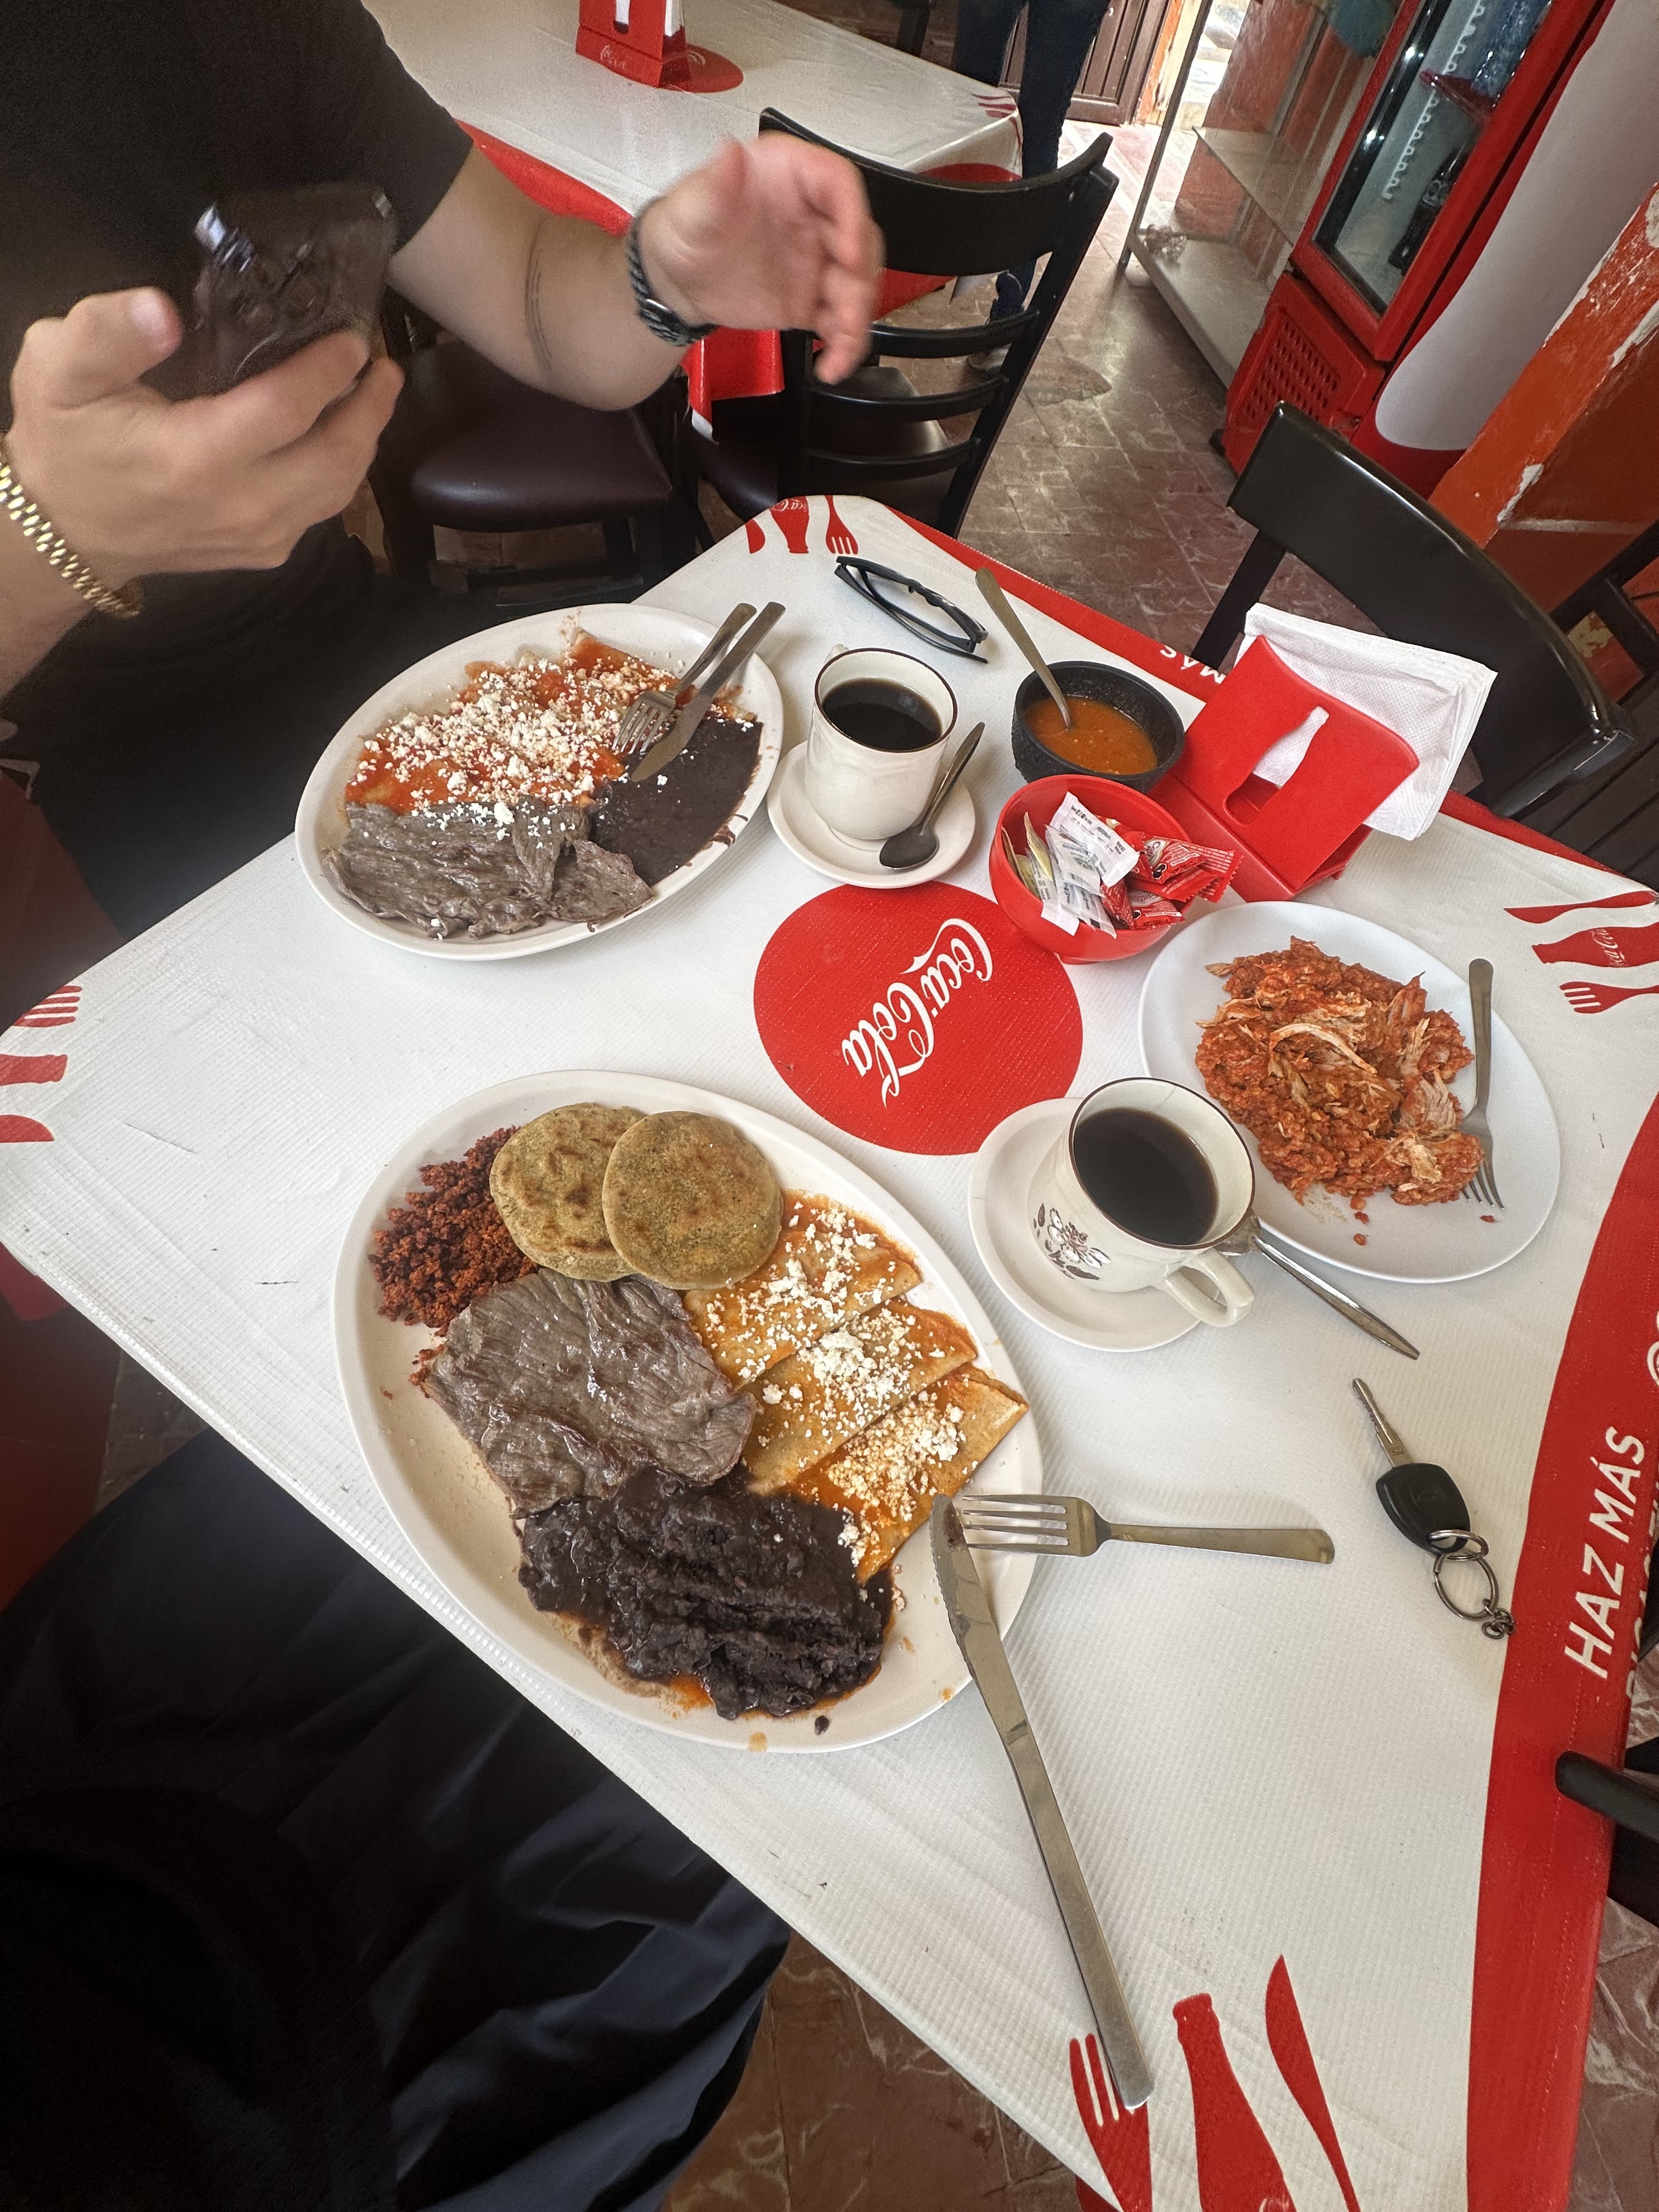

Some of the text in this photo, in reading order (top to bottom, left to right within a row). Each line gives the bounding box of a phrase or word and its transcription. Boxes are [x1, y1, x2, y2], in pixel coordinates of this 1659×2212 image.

[840, 918, 993, 1109] Coca-Cola
[1588, 1426, 1645, 1544] MÁS
[1564, 1543, 1624, 1679] HAZ
